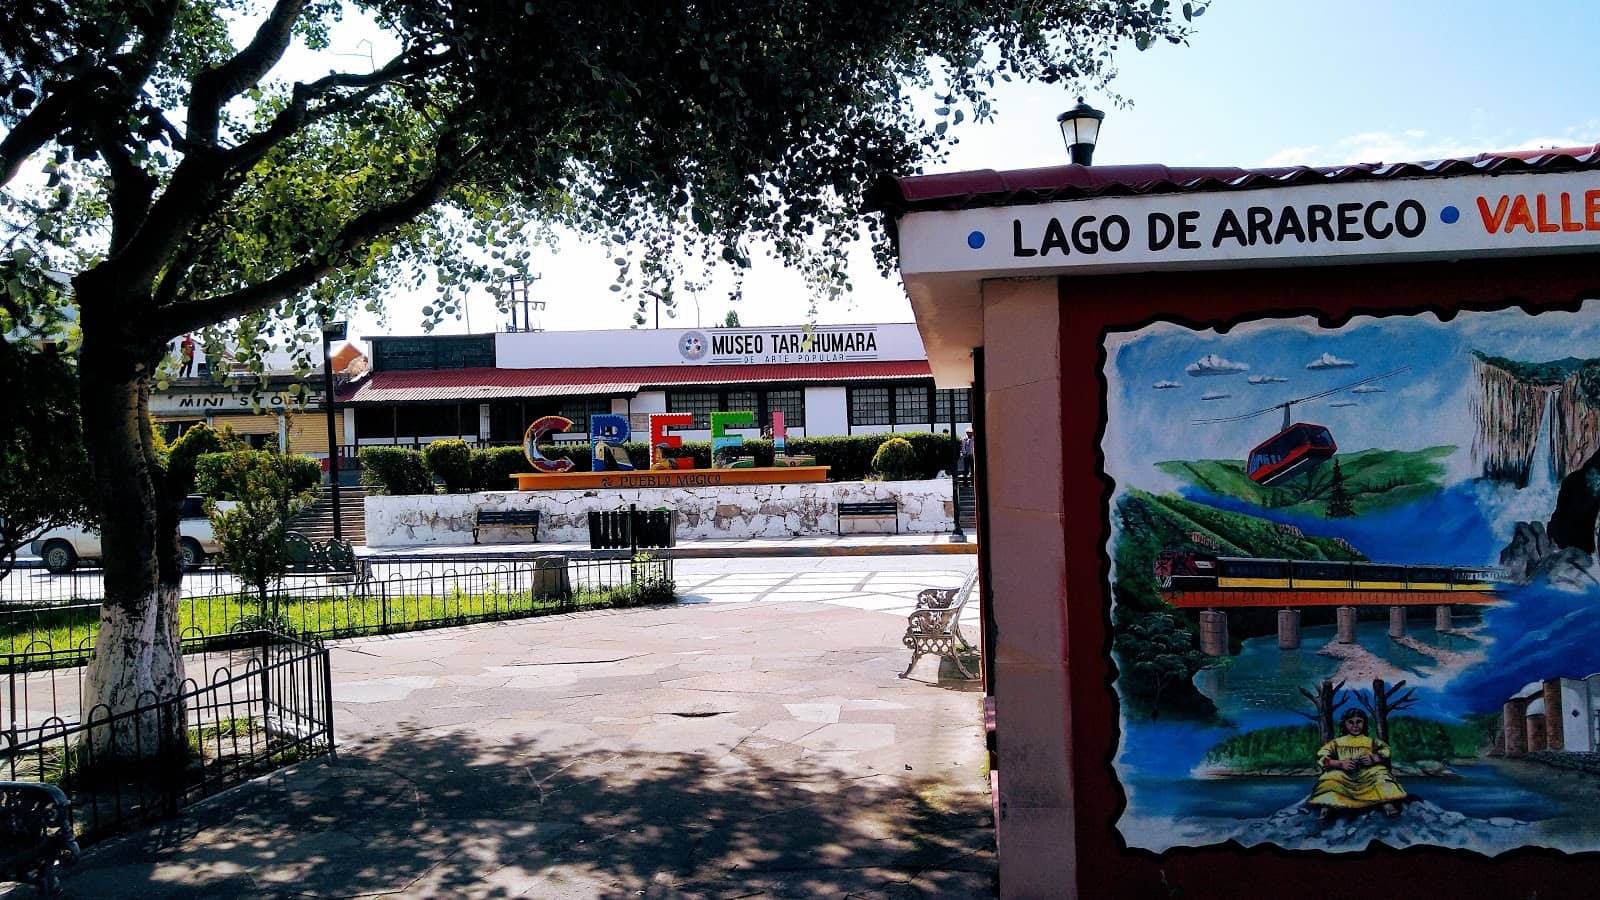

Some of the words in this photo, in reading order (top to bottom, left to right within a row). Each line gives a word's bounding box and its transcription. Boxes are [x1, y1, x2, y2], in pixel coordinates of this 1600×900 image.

[1013, 214, 1130, 257] LAGO
[1148, 211, 1201, 251] DE
[1212, 199, 1427, 248] ARARECO
[1476, 190, 1600, 234] VALLE
[712, 334, 763, 355] MUSEO
[743, 356, 754, 364] DE
[764, 355, 789, 363] ARTE
[798, 353, 844, 362] POPULAR
[179, 397, 224, 407] MINI
[523, 410, 816, 473] CREEL
